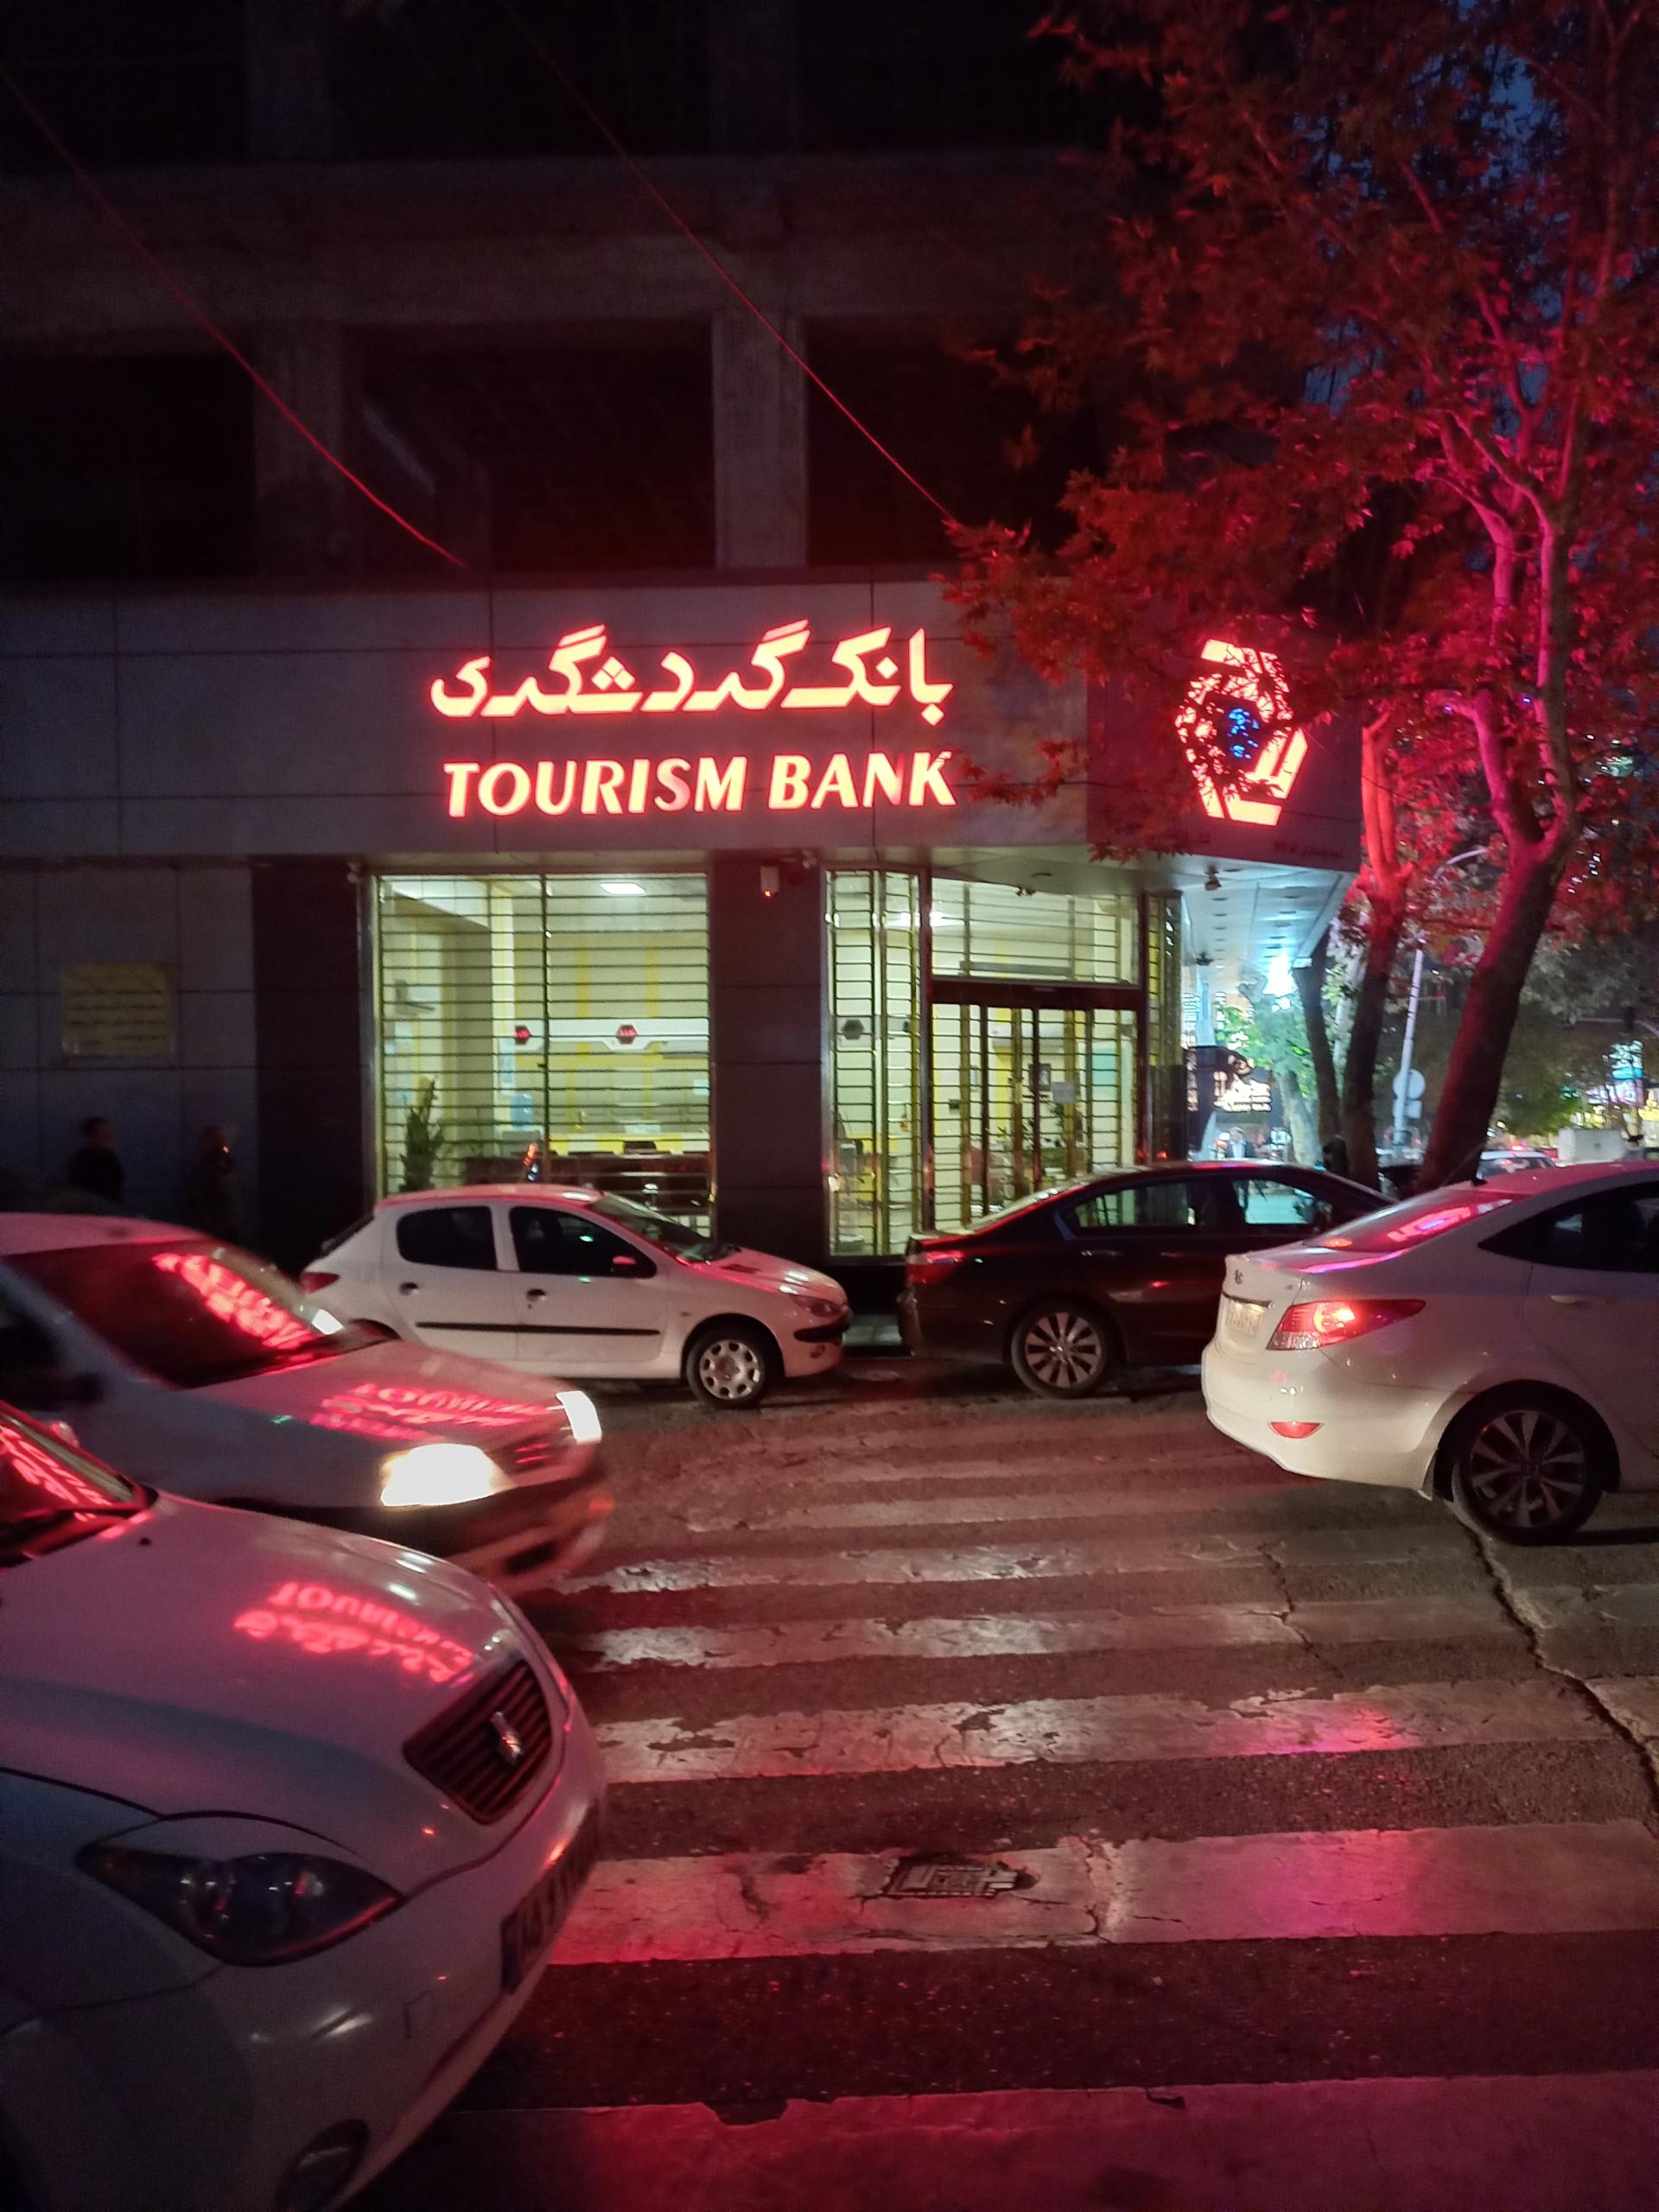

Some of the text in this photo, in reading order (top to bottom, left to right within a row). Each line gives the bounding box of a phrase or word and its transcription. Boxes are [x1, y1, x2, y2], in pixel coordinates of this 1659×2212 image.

[430, 619, 954, 726] بانک گردشگری
[442, 751, 957, 817] TOURISM BANK
